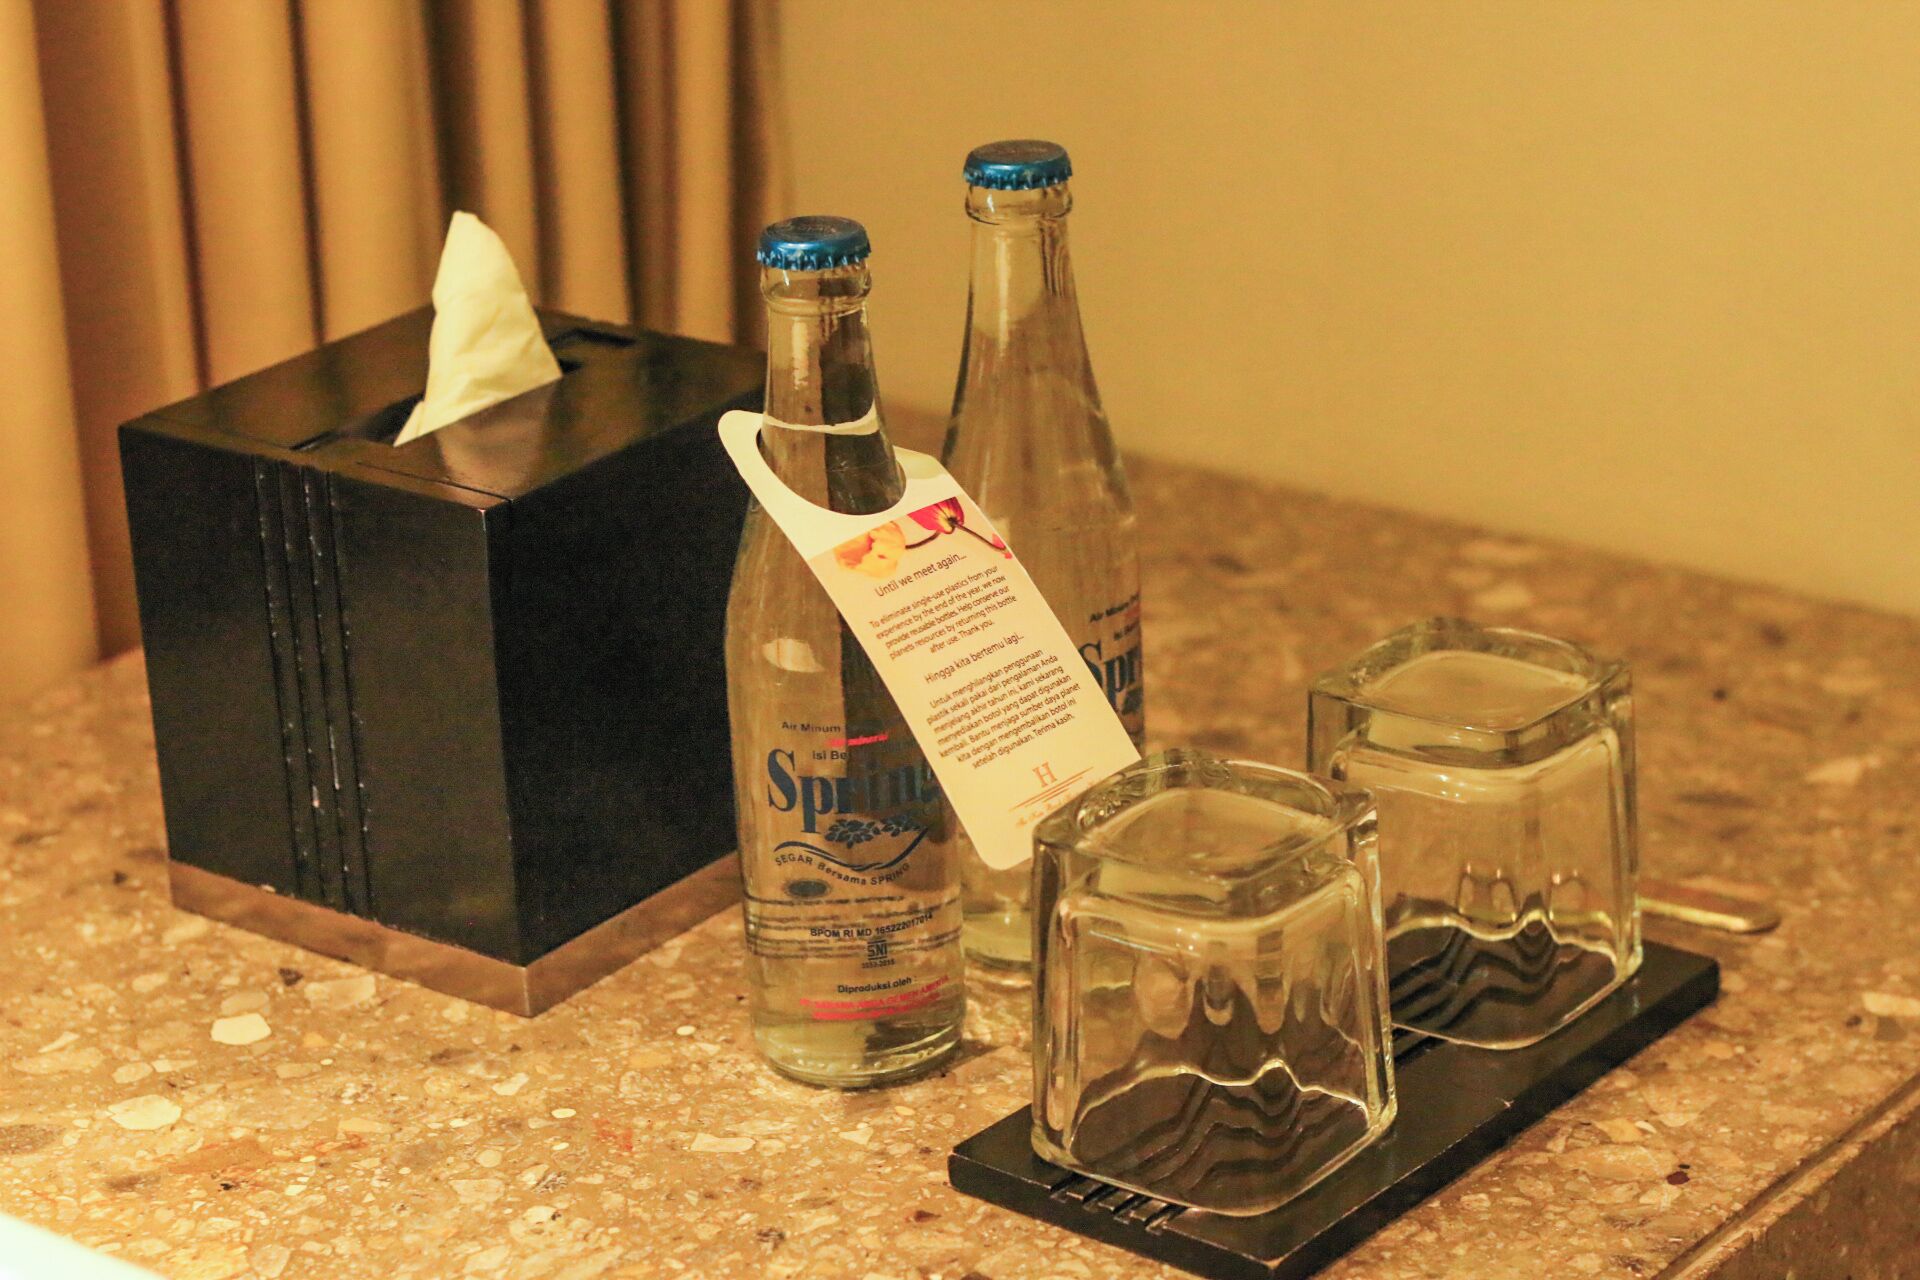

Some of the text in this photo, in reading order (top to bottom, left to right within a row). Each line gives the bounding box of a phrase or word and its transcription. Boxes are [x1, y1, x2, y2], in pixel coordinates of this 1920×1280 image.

[875, 580, 900, 596] Until
[899, 576, 914, 586] we
[913, 564, 938, 579] meet
[880, 606, 912, 624] eliminate
[945, 580, 969, 595] plastics
[968, 573, 985, 582] from
[984, 566, 998, 577] your
[876, 618, 913, 639] experience
[922, 608, 936, 617] the
[935, 600, 949, 611] end
[948, 596, 956, 605] of
[955, 593, 968, 601] the
[992, 576, 1007, 584] now
[886, 633, 911, 649] provide
[910, 621, 937, 635] reusable
[957, 603, 974, 612] Help
[973, 591, 1000, 606] conserve
[998, 586, 1010, 594] our
[915, 629, 947, 645] resources
[956, 610, 987, 627] returning
[985, 605, 999, 613] this
[997, 596, 1017, 607] bottle
[930, 641, 946, 653] after
[958, 625, 981, 637] Thank
[979, 620, 995, 630] you.
[925, 666, 956, 683] Hingga
[954, 658, 972, 668] kita
[970, 642, 1005, 661] bertemu
[930, 650, 1044, 708] Untuk menghilangkan penggunaan
[927, 656, 1059, 725] plastik sekali pakai dari pengalaman Anda
[934, 712, 972, 733] menjelang
[971, 703, 988, 715] akhir
[987, 694, 1009, 706] tahun
[1018, 679, 1035, 691] kami
[1035, 666, 1065, 683] sekarang
[938, 676, 1072, 744] menyediakan botol yang dapat digunakan
[969, 730, 991, 743] Bantu
[991, 714, 1021, 731] menjaga
[1020, 702, 1044, 717] sumber
[1044, 694, 1061, 705] daya
[1060, 684, 1081, 698] planet
[781, 721, 841, 733] Air Minum
[957, 698, 1077, 762] kita dengan mengembalikan botol ini
[973, 752, 998, 768] setelah
[1033, 723, 1057, 736] Terima
[1033, 762, 1058, 787] H
[775, 853, 911, 886] SEGAR Bersama SPRING
[810, 928, 840, 938] BPOM
[843, 929, 853, 938] RI
[856, 928, 872, 937] MD
[867, 943, 888, 957] SNI
[837, 982, 891, 994] Diproduksi
[892, 977, 912, 988] oleh
